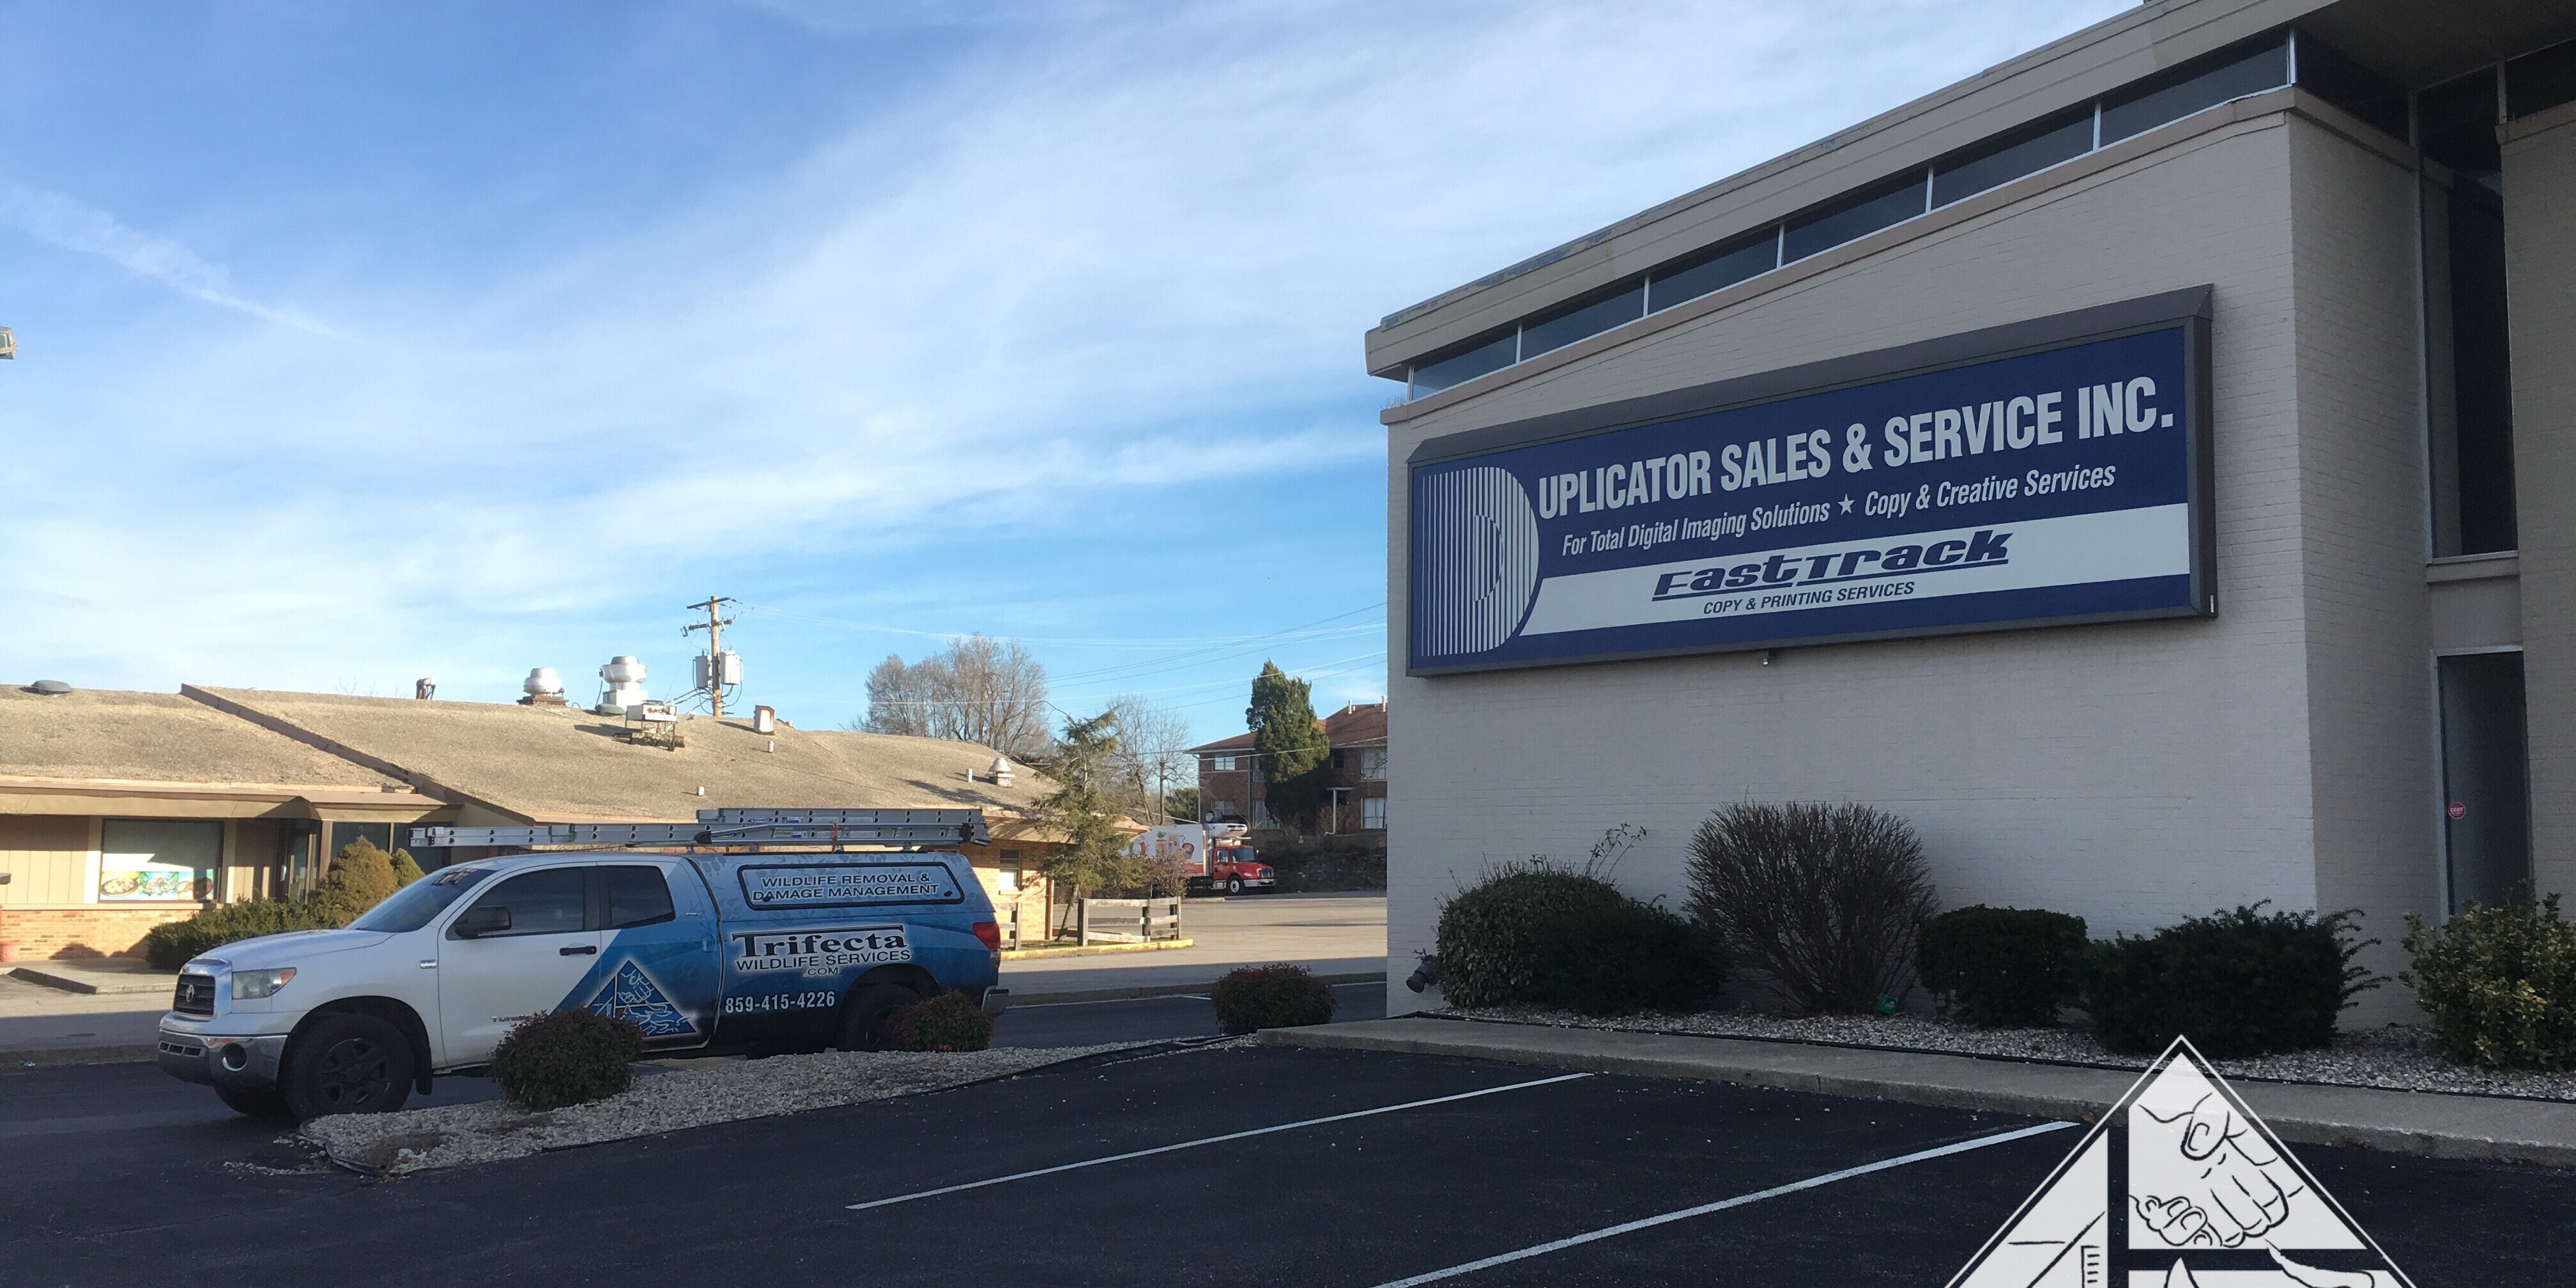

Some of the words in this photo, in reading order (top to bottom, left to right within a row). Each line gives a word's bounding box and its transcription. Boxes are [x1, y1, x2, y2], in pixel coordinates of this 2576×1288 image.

[1721, 429, 1831, 491] SALES
[1843, 423, 1873, 473] &
[1884, 391, 2063, 467] SERVICE
[2078, 376, 2174, 440] INC.
[1562, 534, 1588, 556] For
[1590, 527, 1625, 552] Total
[1628, 519, 1678, 550] Digital
[1682, 512, 1747, 540] Imaging
[1751, 502, 1830, 531] Solutions
[1865, 491, 1912, 519] Copy
[1915, 484, 1931, 510] &
[1936, 475, 2018, 507] Creative
[2024, 464, 2116, 496] Services
[1703, 599, 1743, 615] COPY
[1746, 597, 1756, 611] &
[1760, 589, 1833, 608] PRINTING
[1837, 581, 1915, 602] SERVICES
[753, 888, 823, 901] DAMAGE
[828, 884, 939, 898] MANAGEMENT
[762, 875, 837, 887] WILDLIFE
[841, 873, 916, 885] REMOVAL
[920, 873, 931, 882] &
[732, 924, 907, 958] Trifecta
[736, 958, 820, 971] WILDLIFE
[826, 950, 911, 966] SERVICES
[725, 991, 836, 1014] 859-415-4226
